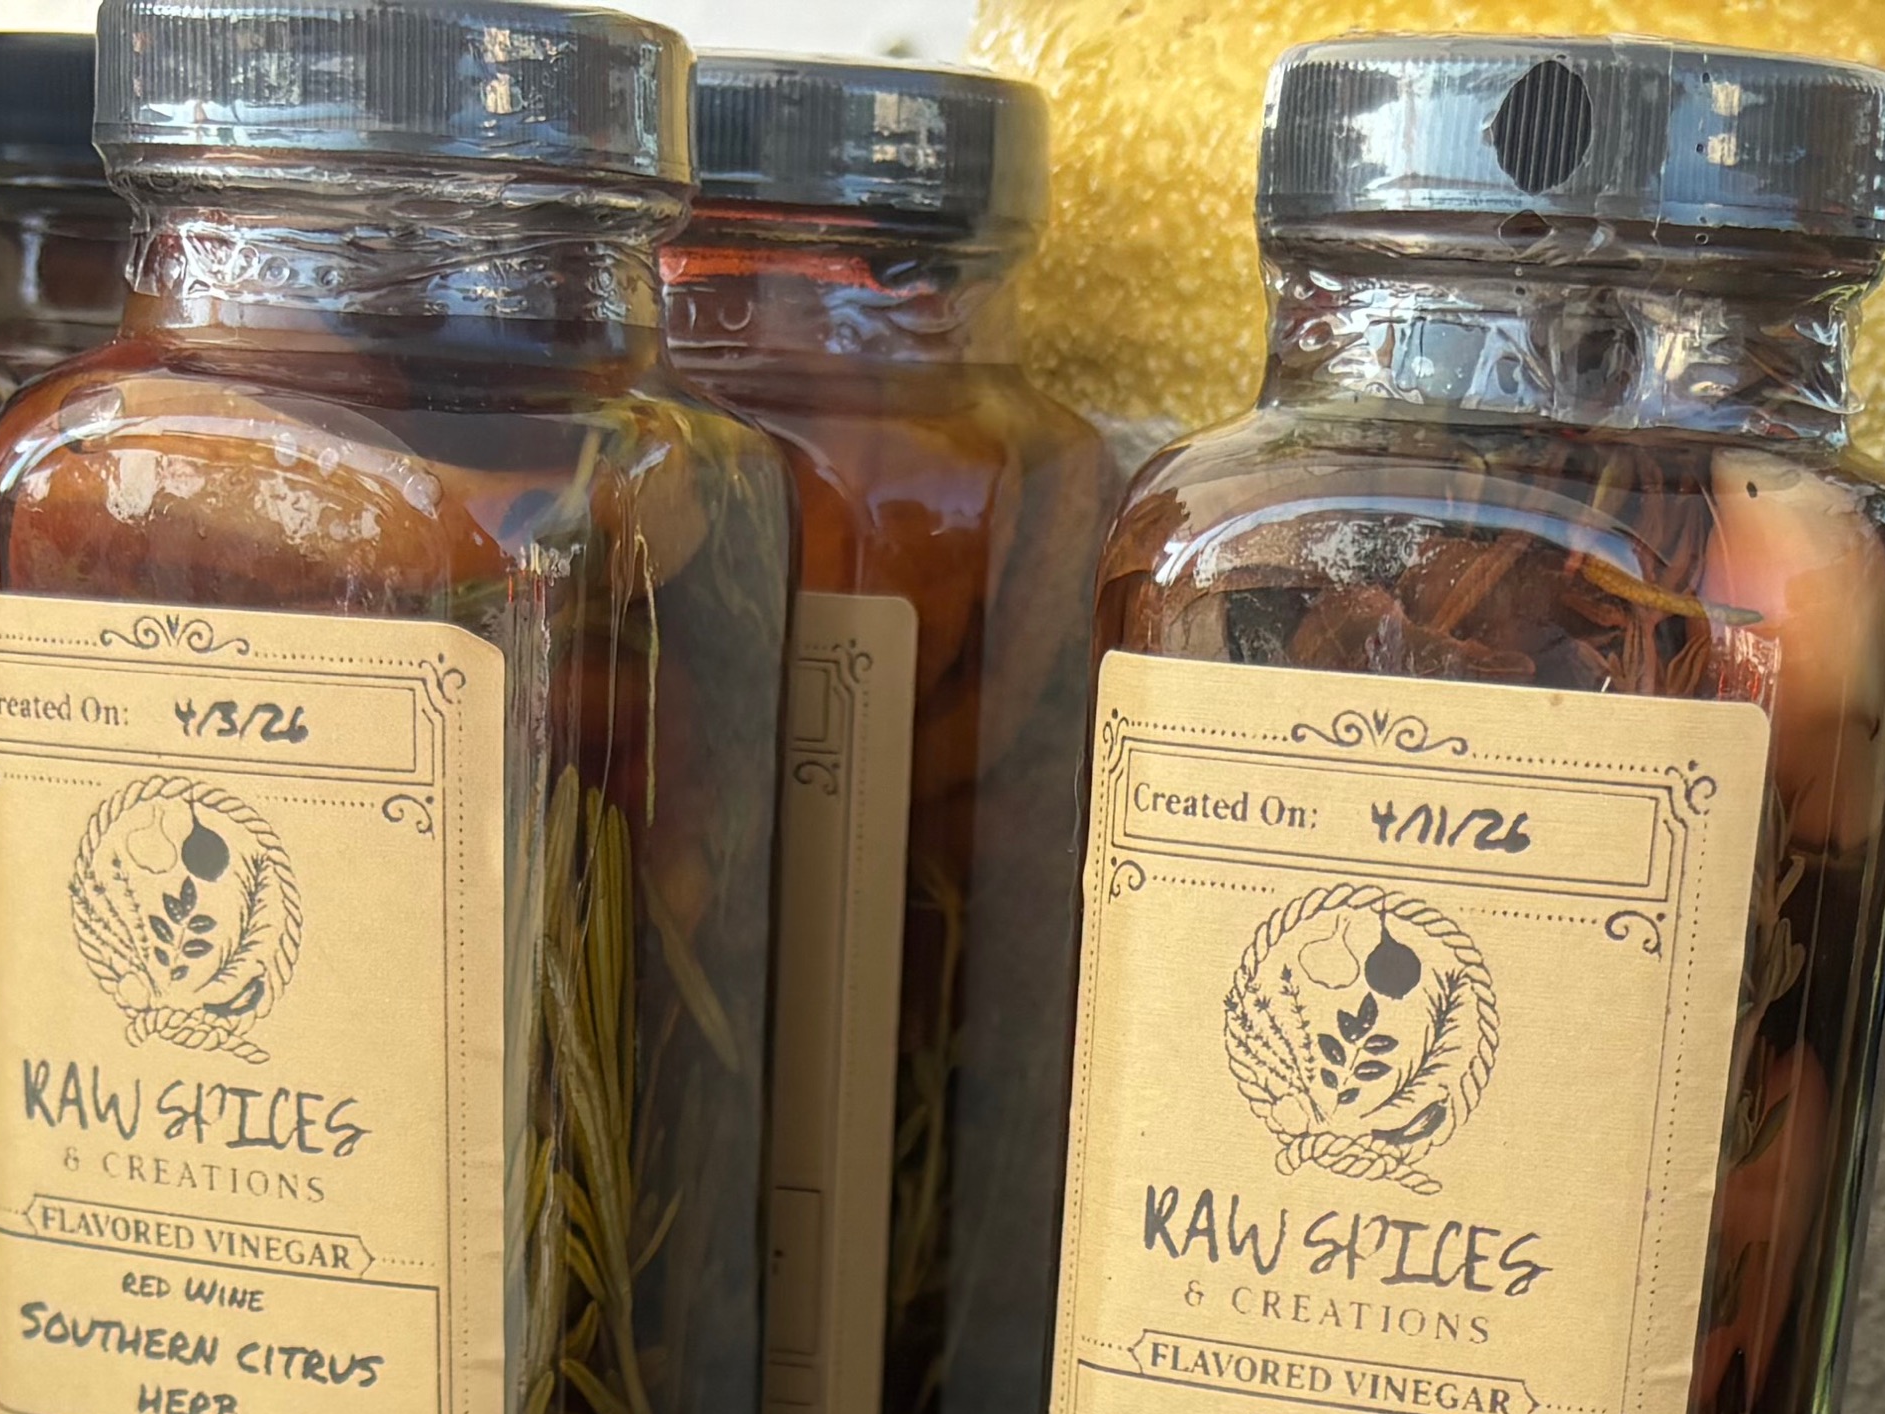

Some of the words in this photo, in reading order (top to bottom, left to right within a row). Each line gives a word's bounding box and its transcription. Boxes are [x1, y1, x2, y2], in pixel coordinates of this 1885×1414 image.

[81, 697, 129, 727] On:
[175, 698, 310, 744] 4/3/26
[1133, 782, 1249, 824] Created
[1260, 795, 1318, 830] On:
[1371, 799, 1532, 854] 4/11/26
[23, 1059, 140, 1141] RAW
[156, 1080, 373, 1158] SPICES
[64, 1146, 80, 1172] &
[102, 1151, 326, 1203] CREATIONS
[40, 1204, 196, 1252] FLAVORED
[205, 1228, 352, 1270] VINEGAR
[1143, 1184, 1288, 1276] RAW
[1302, 1210, 1554, 1297] SPICES
[121, 1271, 171, 1298] RED
[184, 1278, 265, 1313] WINE
[1184, 1280, 1205, 1307] &
[1231, 1286, 1490, 1345] CREATIONS
[20, 1300, 219, 1367] SOUTHERN
[237, 1341, 385, 1388] CITRUS
[1149, 1342, 1333, 1393] FLAVORED
